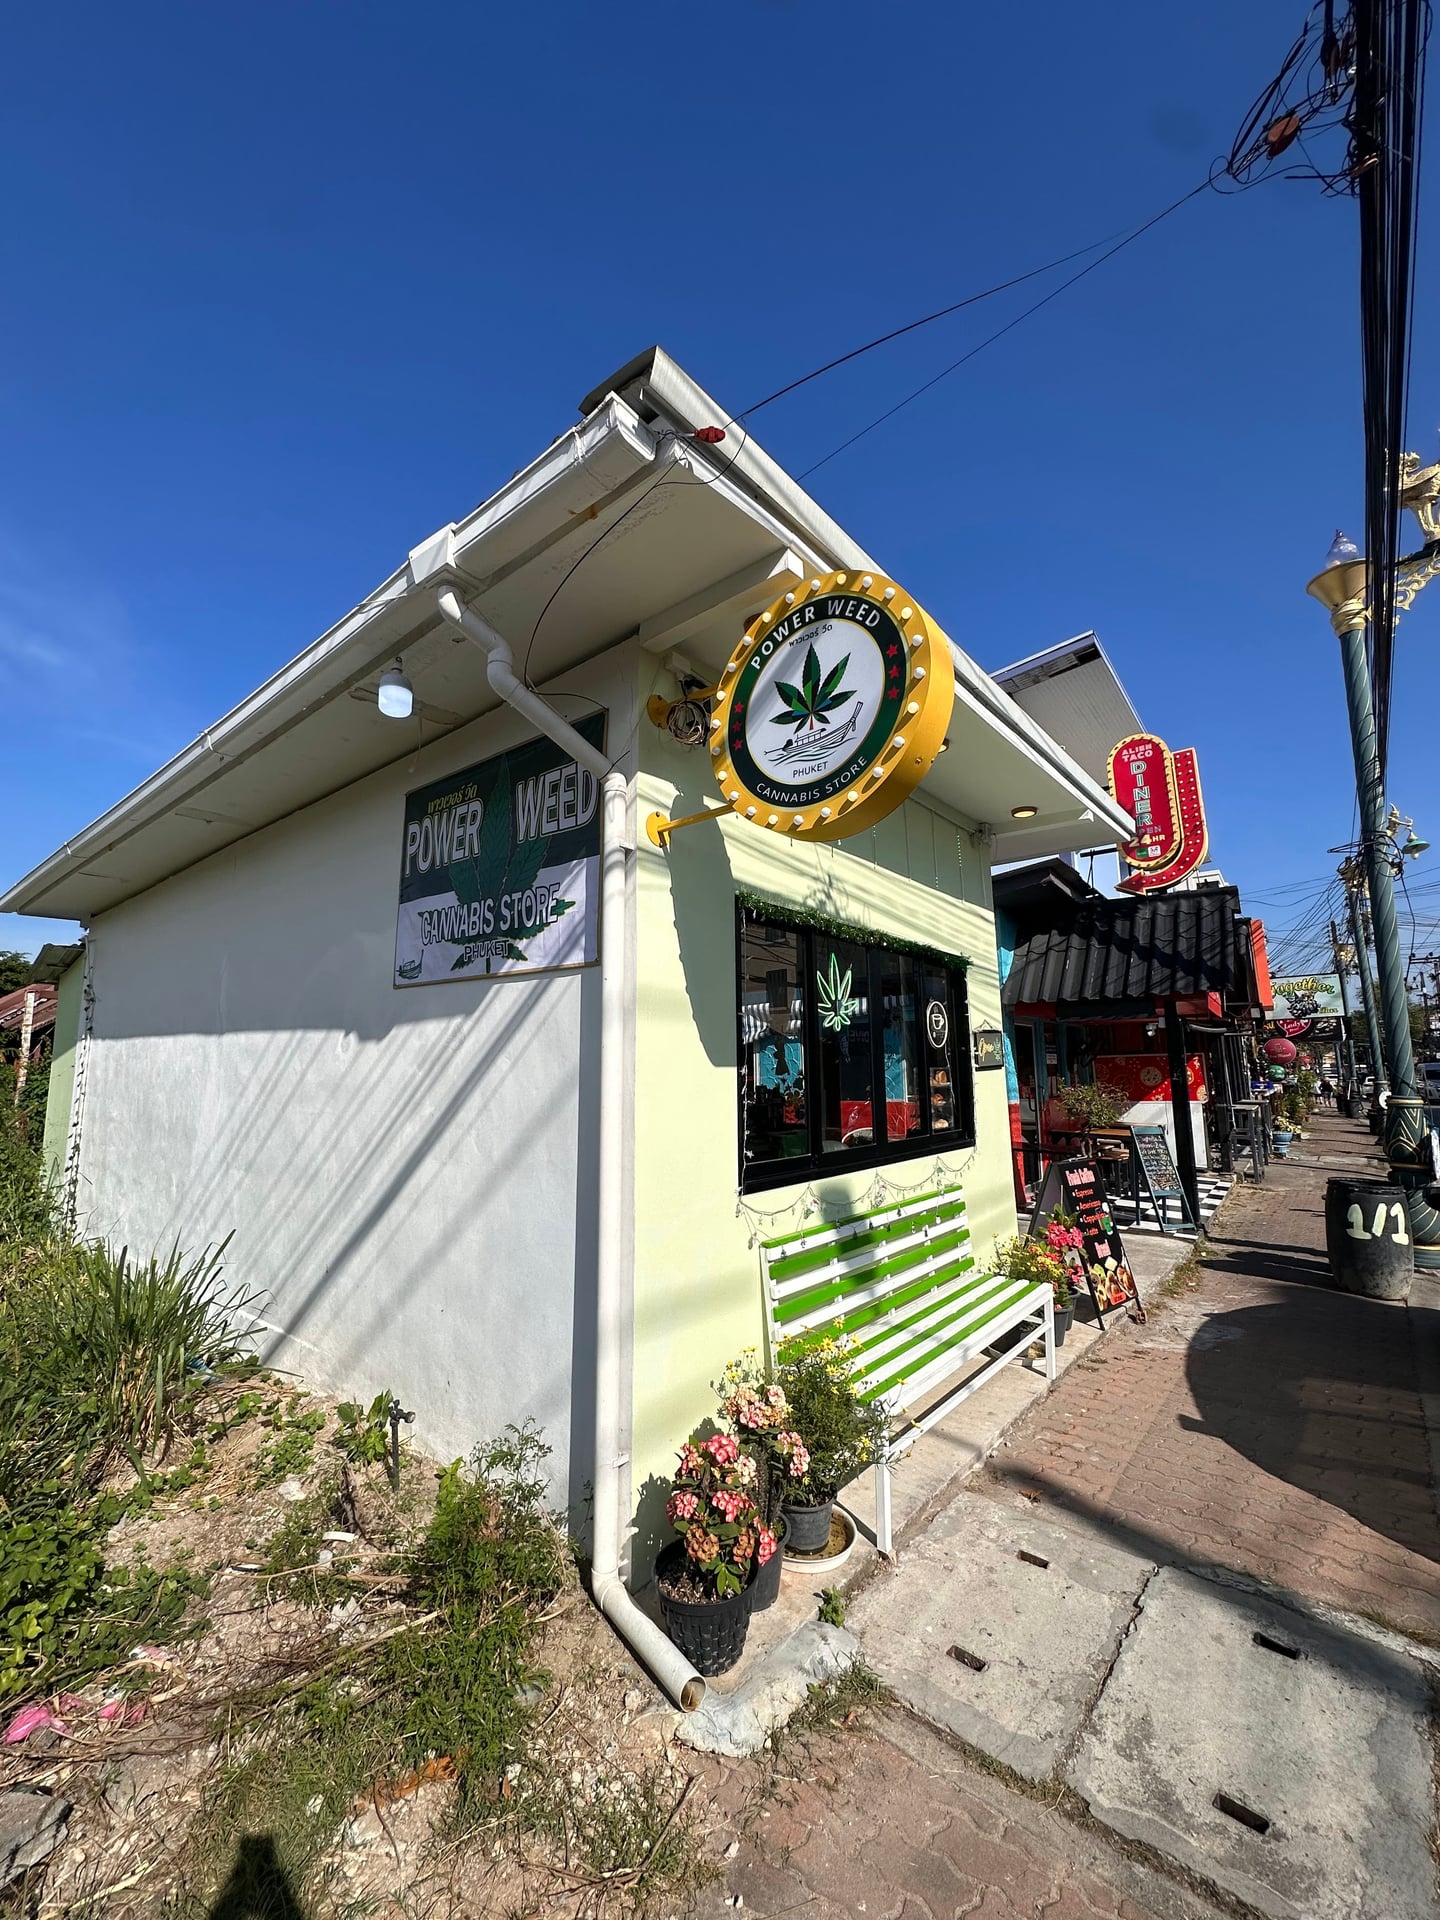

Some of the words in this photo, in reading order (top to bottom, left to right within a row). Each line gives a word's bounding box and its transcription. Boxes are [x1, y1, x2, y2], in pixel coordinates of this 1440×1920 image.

[751, 605, 816, 670] POWER
[828, 599, 881, 629] WEED
[792, 761, 829, 778] PHUKET
[1122, 743, 1152, 756] ALIEN
[1122, 750, 1153, 763] TACO
[515, 760, 599, 844] WEED
[756, 781, 820, 803] CANNABIS
[825, 756, 868, 794] STORE
[1130, 761, 1153, 826] DINER
[404, 797, 484, 878] POWER
[1138, 825, 1162, 836] PEN
[420, 898, 495, 946] CANNABIS
[499, 882, 561, 936] STORE
[463, 939, 512, 962] PHUKET
[1345, 1201, 1410, 1246] 1/1
